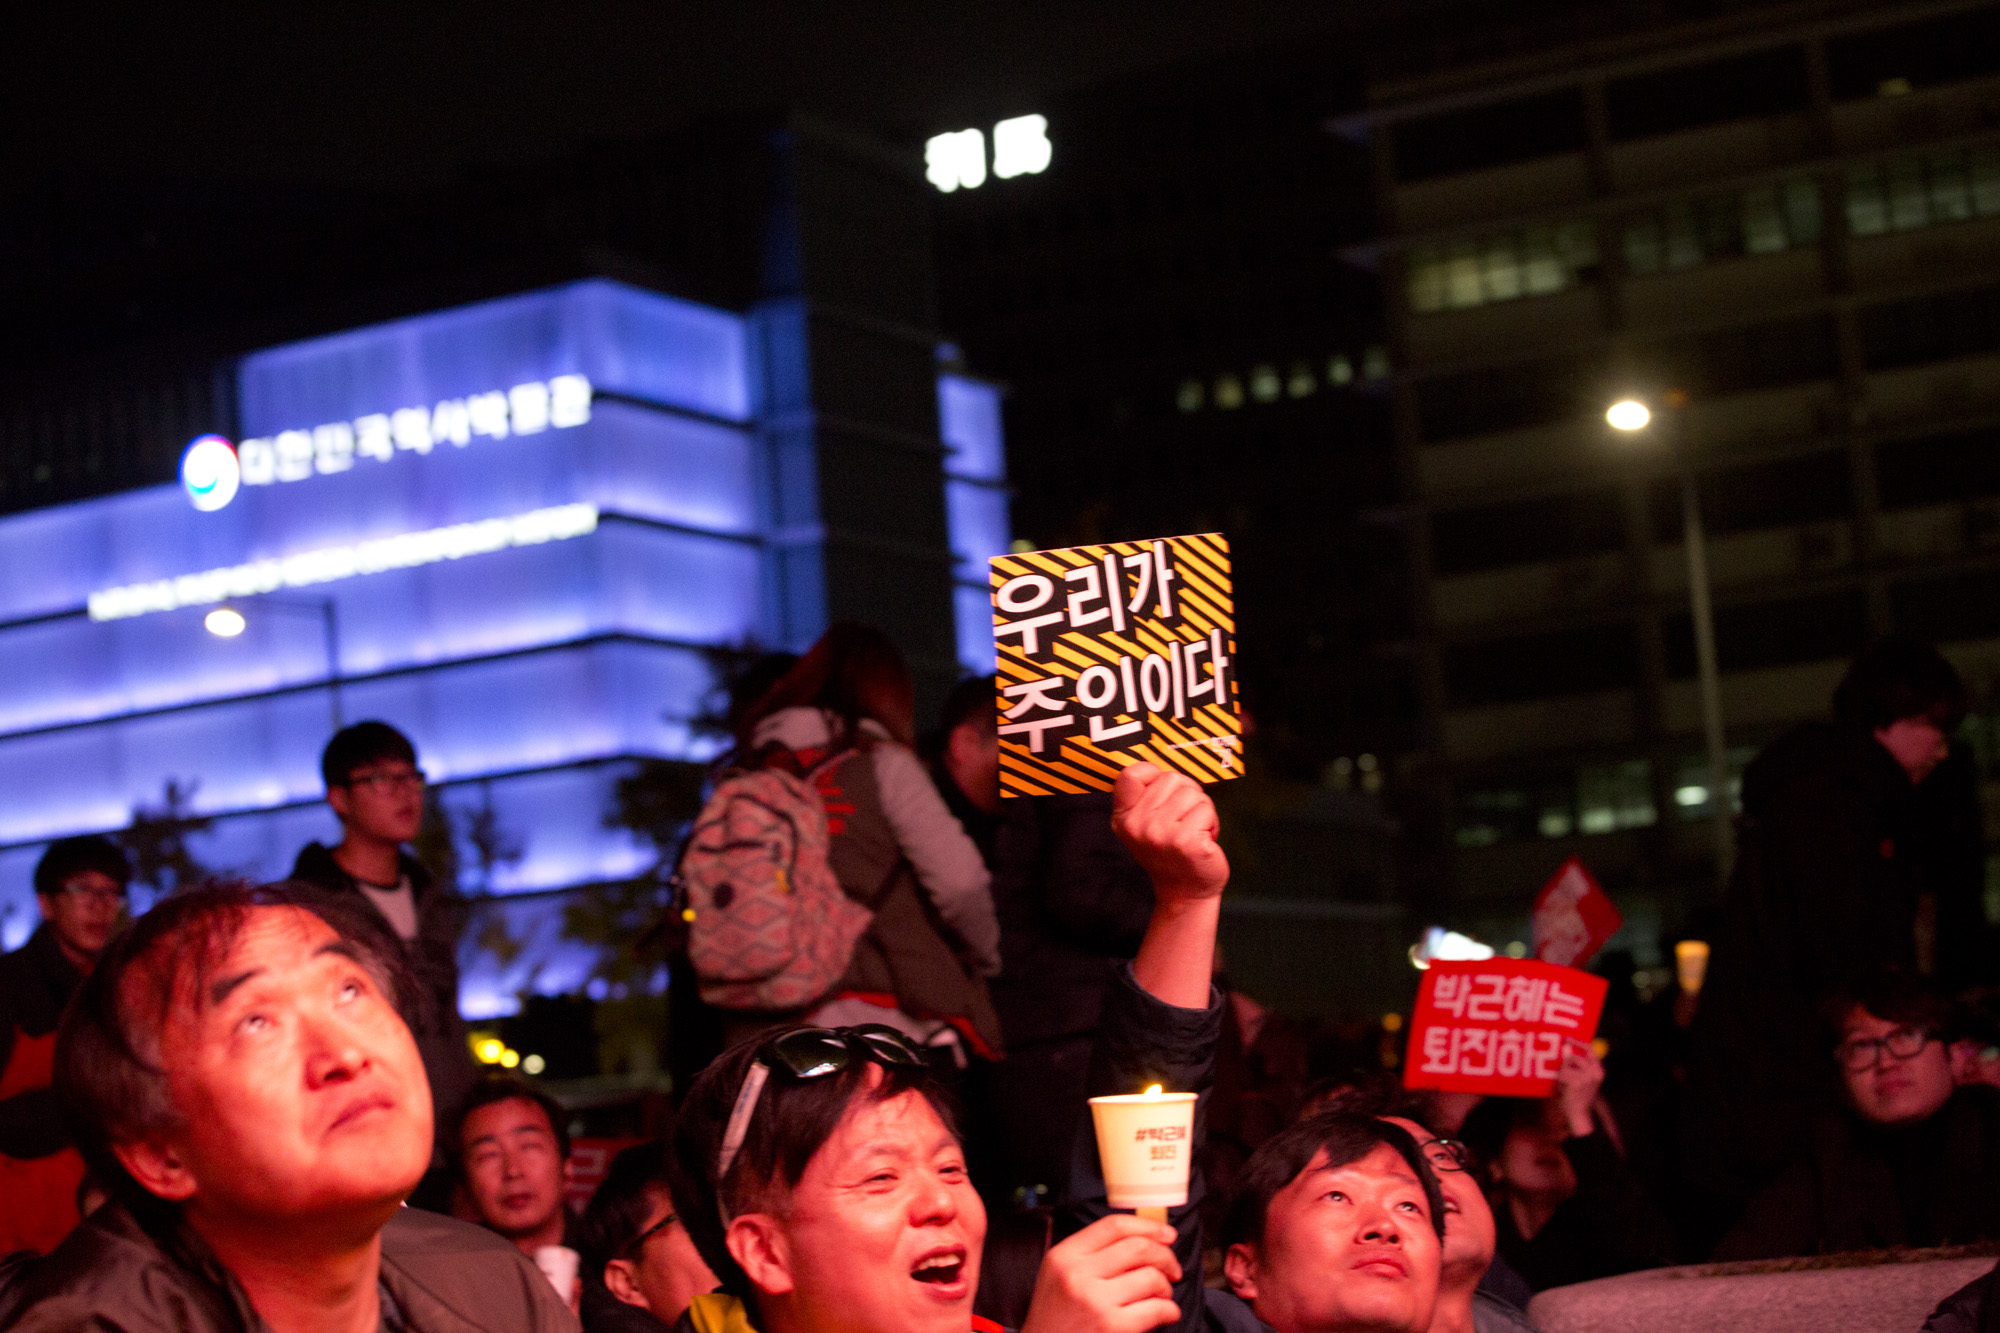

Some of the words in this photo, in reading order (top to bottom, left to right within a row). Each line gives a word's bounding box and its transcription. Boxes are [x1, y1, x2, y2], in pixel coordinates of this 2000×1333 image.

[992, 540, 1175, 655] 우리가
[997, 628, 1229, 753] 주인이다
[1432, 974, 1584, 1029] 박근혜는
